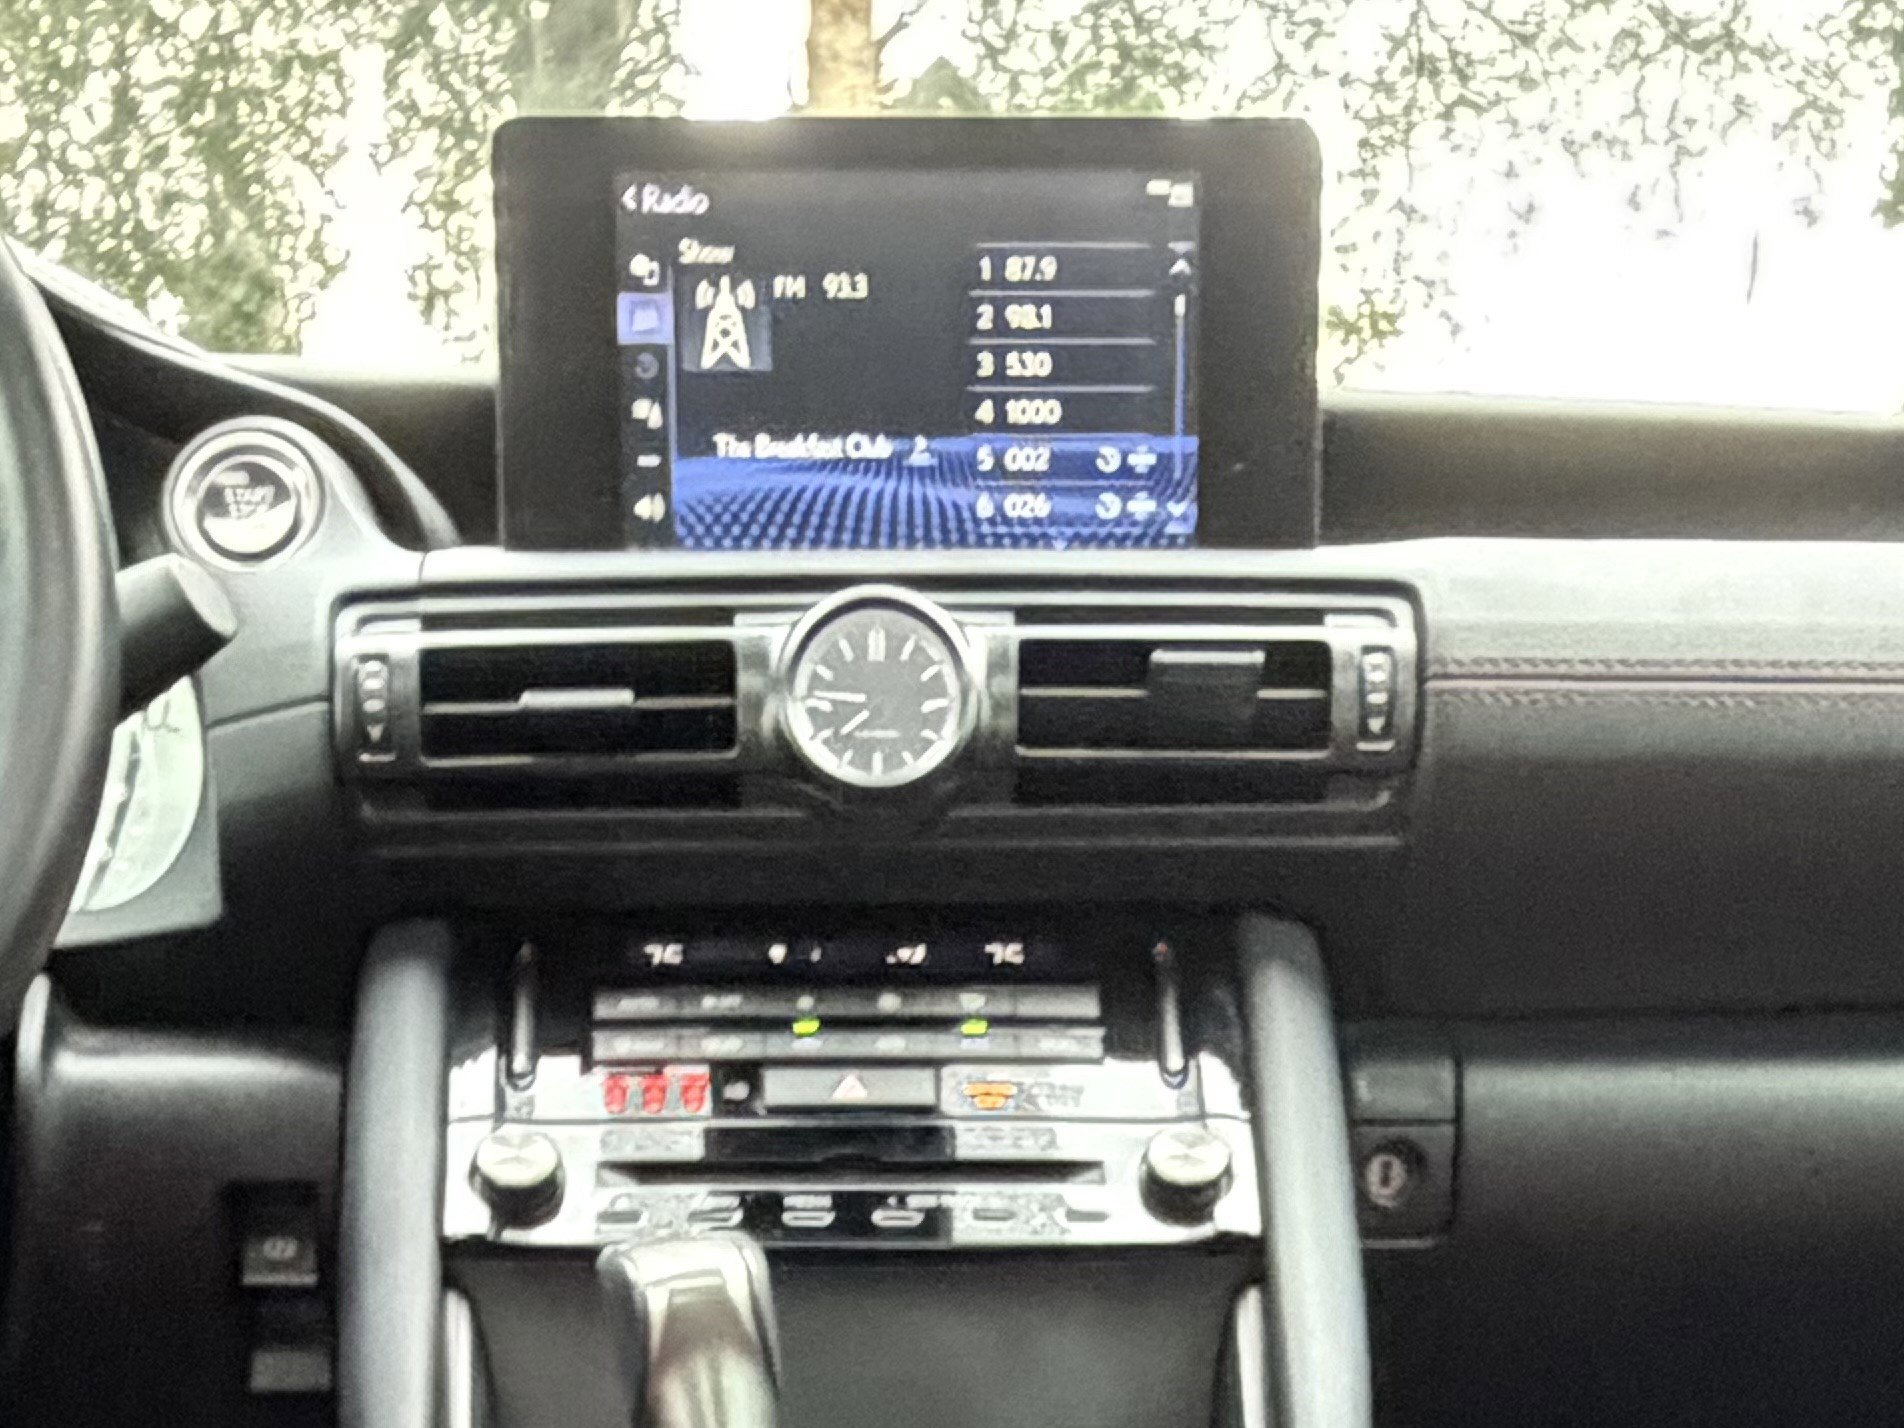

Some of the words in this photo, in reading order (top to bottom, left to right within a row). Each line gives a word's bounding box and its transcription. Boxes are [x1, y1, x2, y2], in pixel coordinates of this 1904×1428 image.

[642, 183, 710, 216] Radio
[979, 255, 992, 282] 1
[1004, 255, 1058, 282] 87.9
[772, 274, 807, 299] FM
[976, 303, 994, 331] 2
[976, 351, 995, 378] 3
[974, 398, 995, 425] 4
[1005, 398, 1063, 425] 1000
[712, 431, 752, 460] The
[976, 444, 994, 472] 5
[1003, 446, 1051, 472] 002
[975, 491, 995, 519] 6
[1003, 492, 1052, 519] 026
